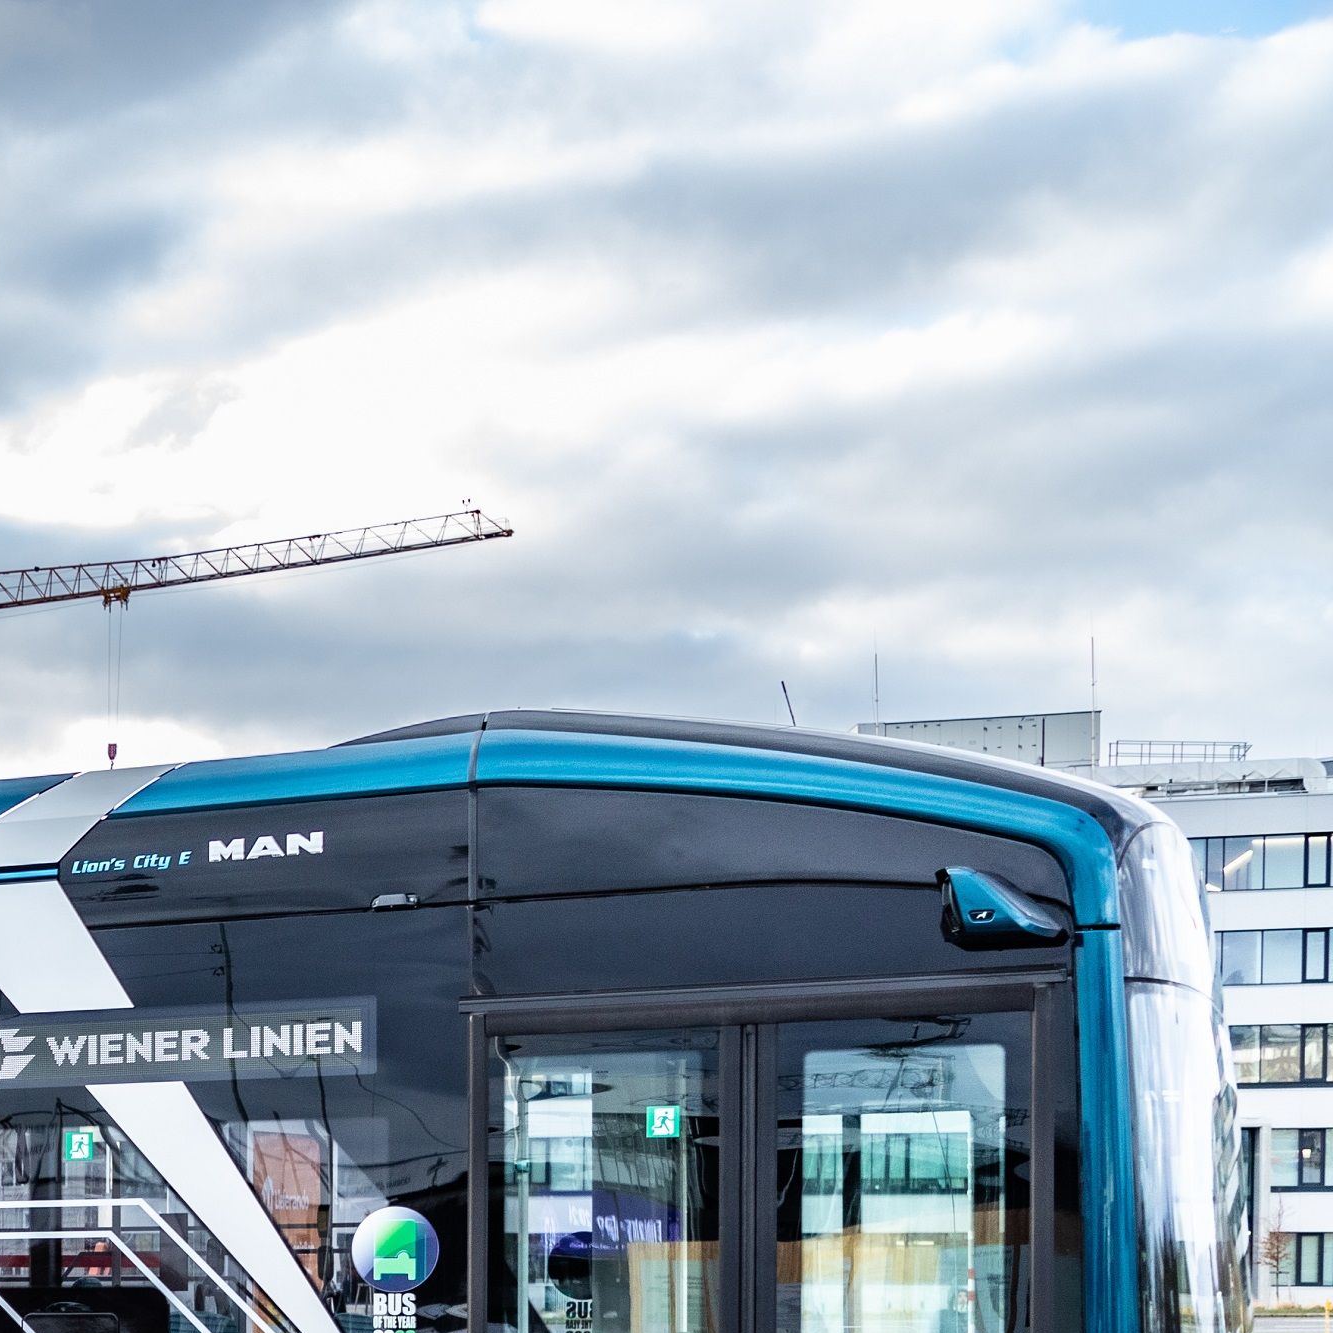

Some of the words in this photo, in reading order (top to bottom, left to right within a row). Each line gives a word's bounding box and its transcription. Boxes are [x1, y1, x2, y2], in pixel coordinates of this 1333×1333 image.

[208, 831, 324, 862] MAN
[71, 857, 126, 874] Lion's
[132, 854, 172, 871] City
[178, 850, 192, 865] E
[46, 1028, 210, 1067] WIENER
[223, 1021, 362, 1059] LINIEN
[373, 1292, 416, 1316] BUS
[373, 1316, 383, 1329] OF
[383, 1316, 397, 1329] THE
[397, 1316, 416, 1329] YEAR
